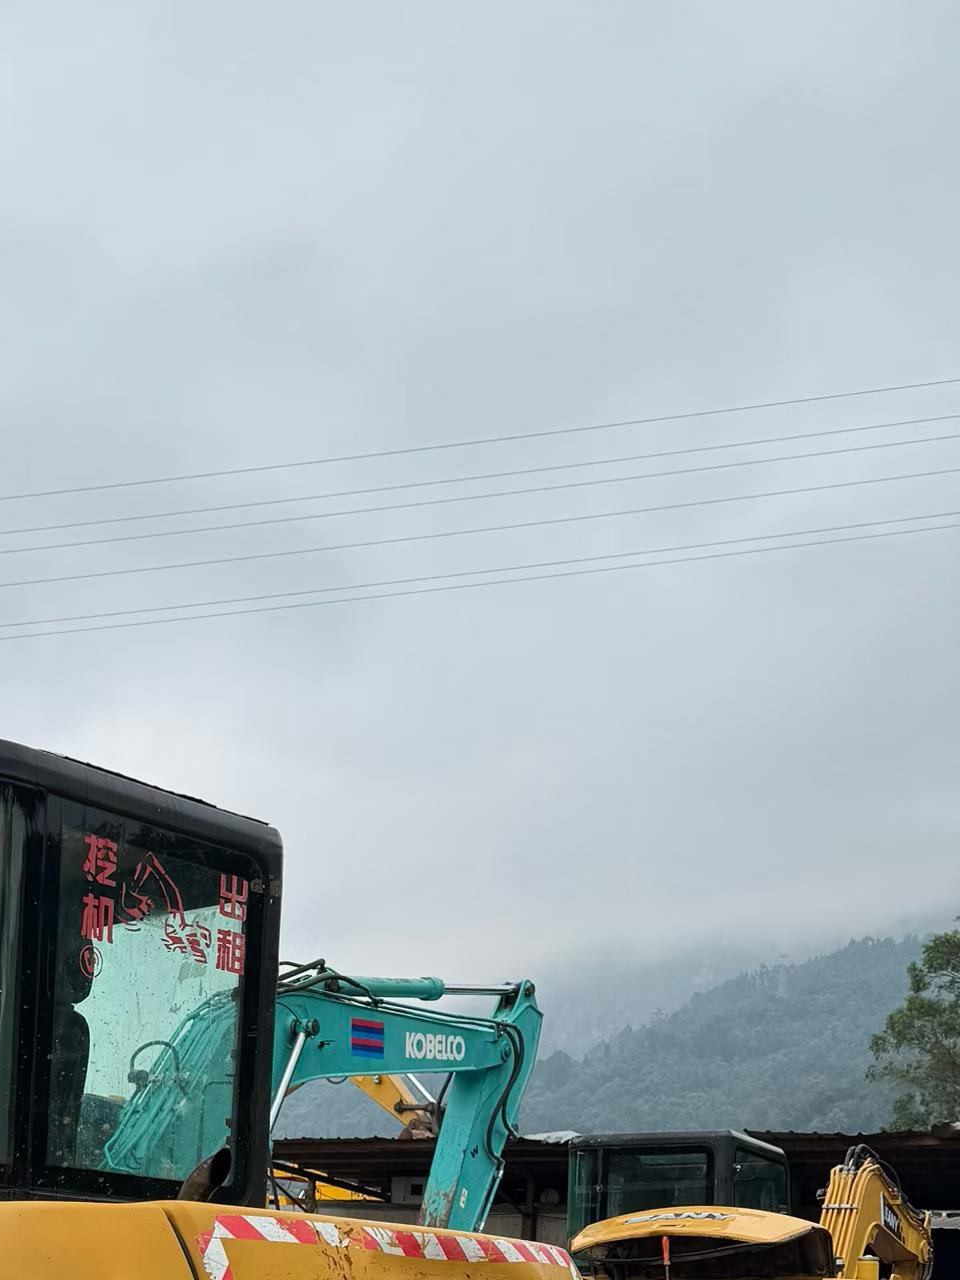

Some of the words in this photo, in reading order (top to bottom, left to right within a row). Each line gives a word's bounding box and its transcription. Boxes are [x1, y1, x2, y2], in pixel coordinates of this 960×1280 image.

[80, 833, 118, 944] 挖机
[216, 873, 249, 975] 出租
[405, 1031, 466, 1061] KOBELCO
